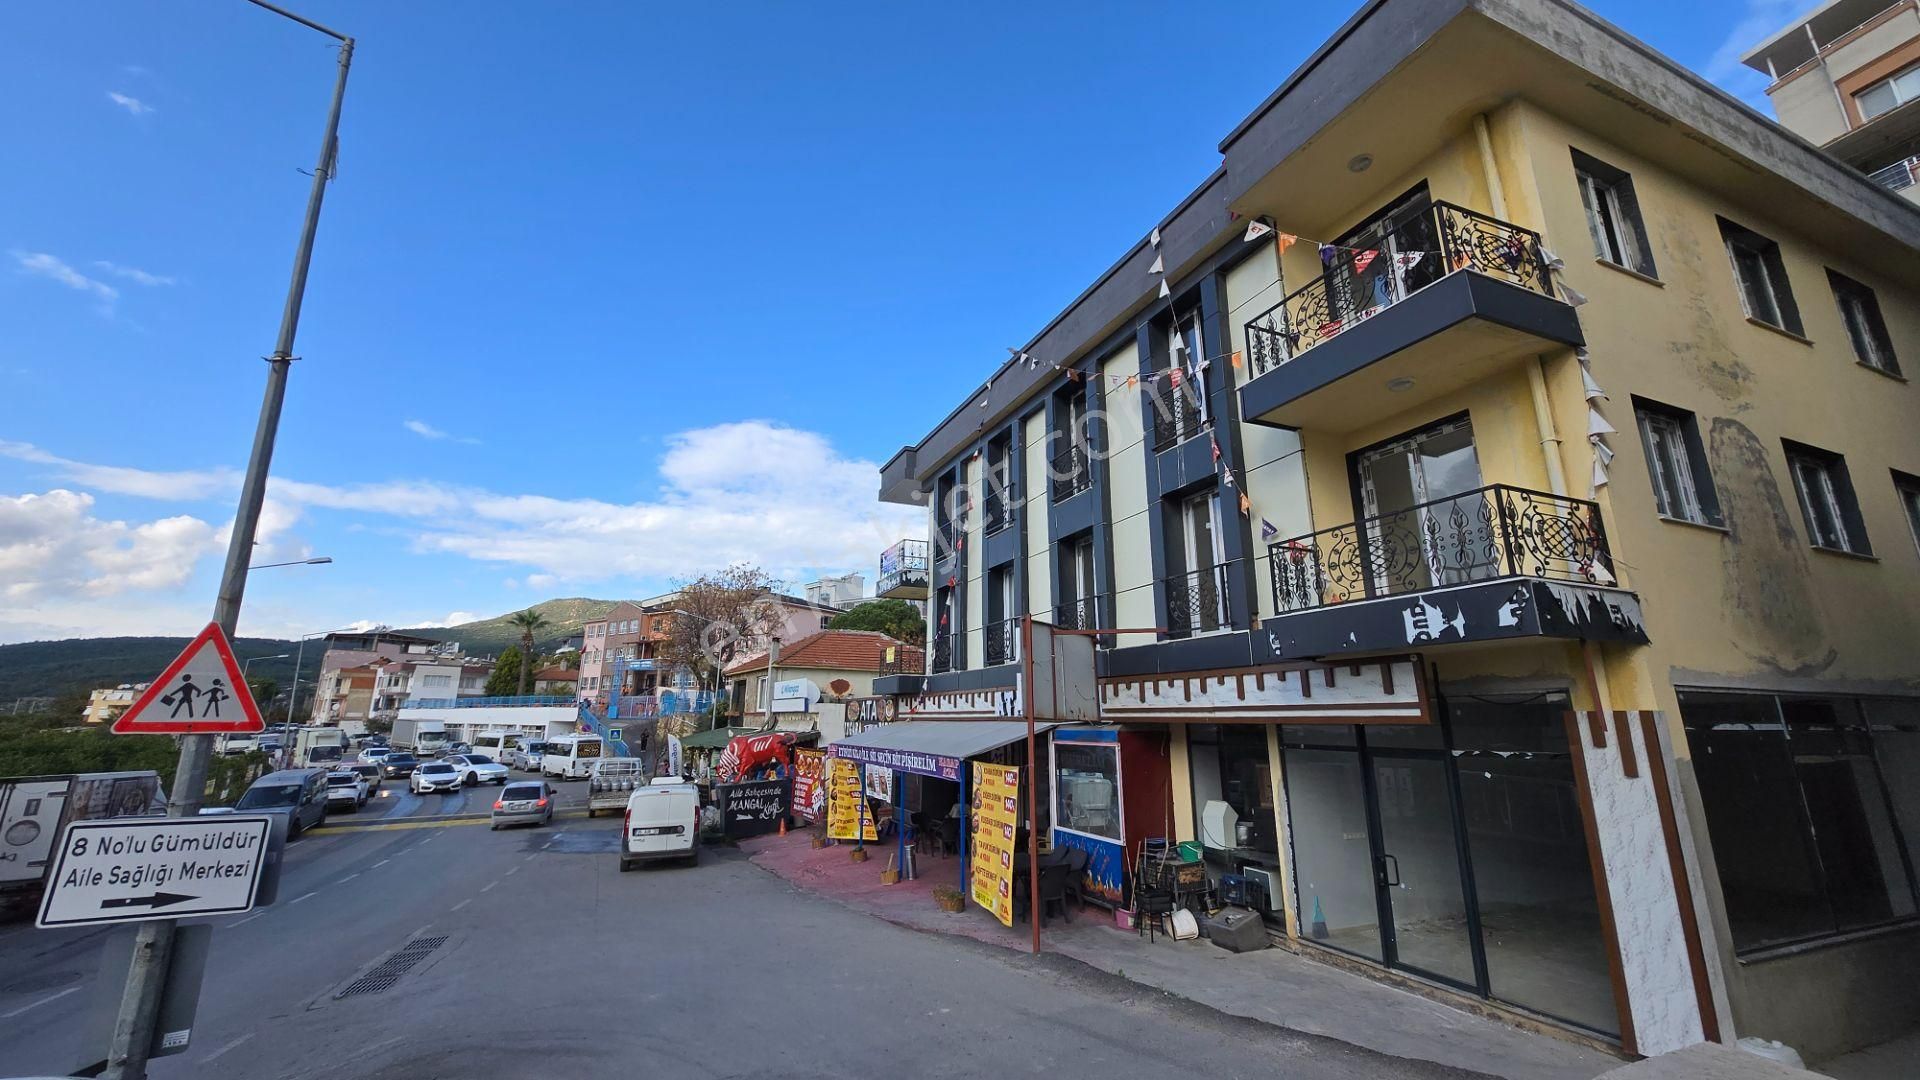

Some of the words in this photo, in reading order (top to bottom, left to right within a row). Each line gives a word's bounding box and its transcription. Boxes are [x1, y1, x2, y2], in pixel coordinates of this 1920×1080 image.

[1251, 226, 1263, 235] ET
[860, 700, 877, 721] ATA
[902, 752, 936, 772] PİŞİRELİM
[728, 799, 764, 812] MANGAL
[71, 837, 88, 856] 8
[96, 835, 147, 855] No'lu
[151, 832, 257, 852] Gümüldür
[63, 868, 102, 888] Aile
[109, 864, 173, 888] Sağlığı
[179, 860, 251, 880] Merkezi
